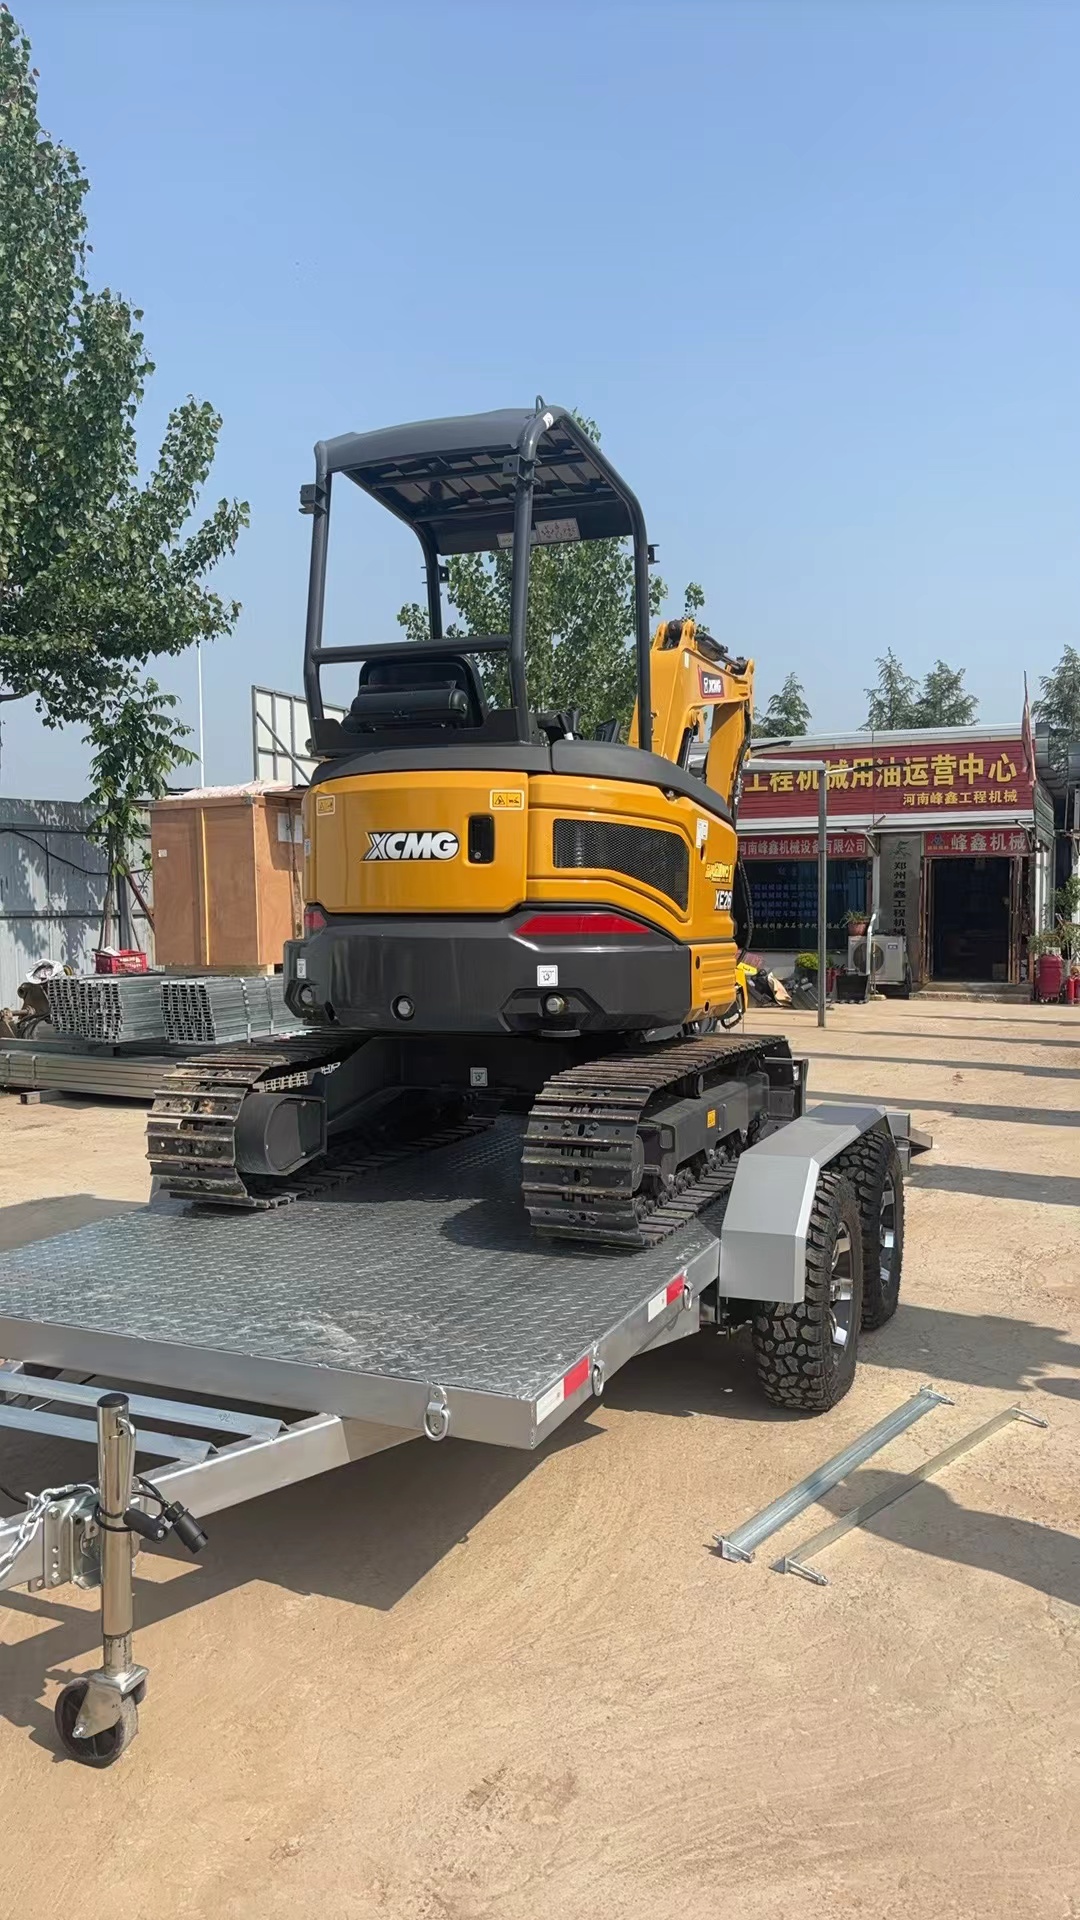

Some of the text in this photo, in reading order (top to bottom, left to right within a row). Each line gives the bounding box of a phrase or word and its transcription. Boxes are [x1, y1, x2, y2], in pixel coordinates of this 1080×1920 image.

[744, 752, 1018, 793] 工程机械用油运营中心
[903, 789, 1018, 806] 河南峰鑫工程机械
[364, 832, 459, 860] XCMG
[738, 838, 867, 856] 河南峰鑫机械设备有限公司
[951, 832, 1027, 852] 峰鑫机械
